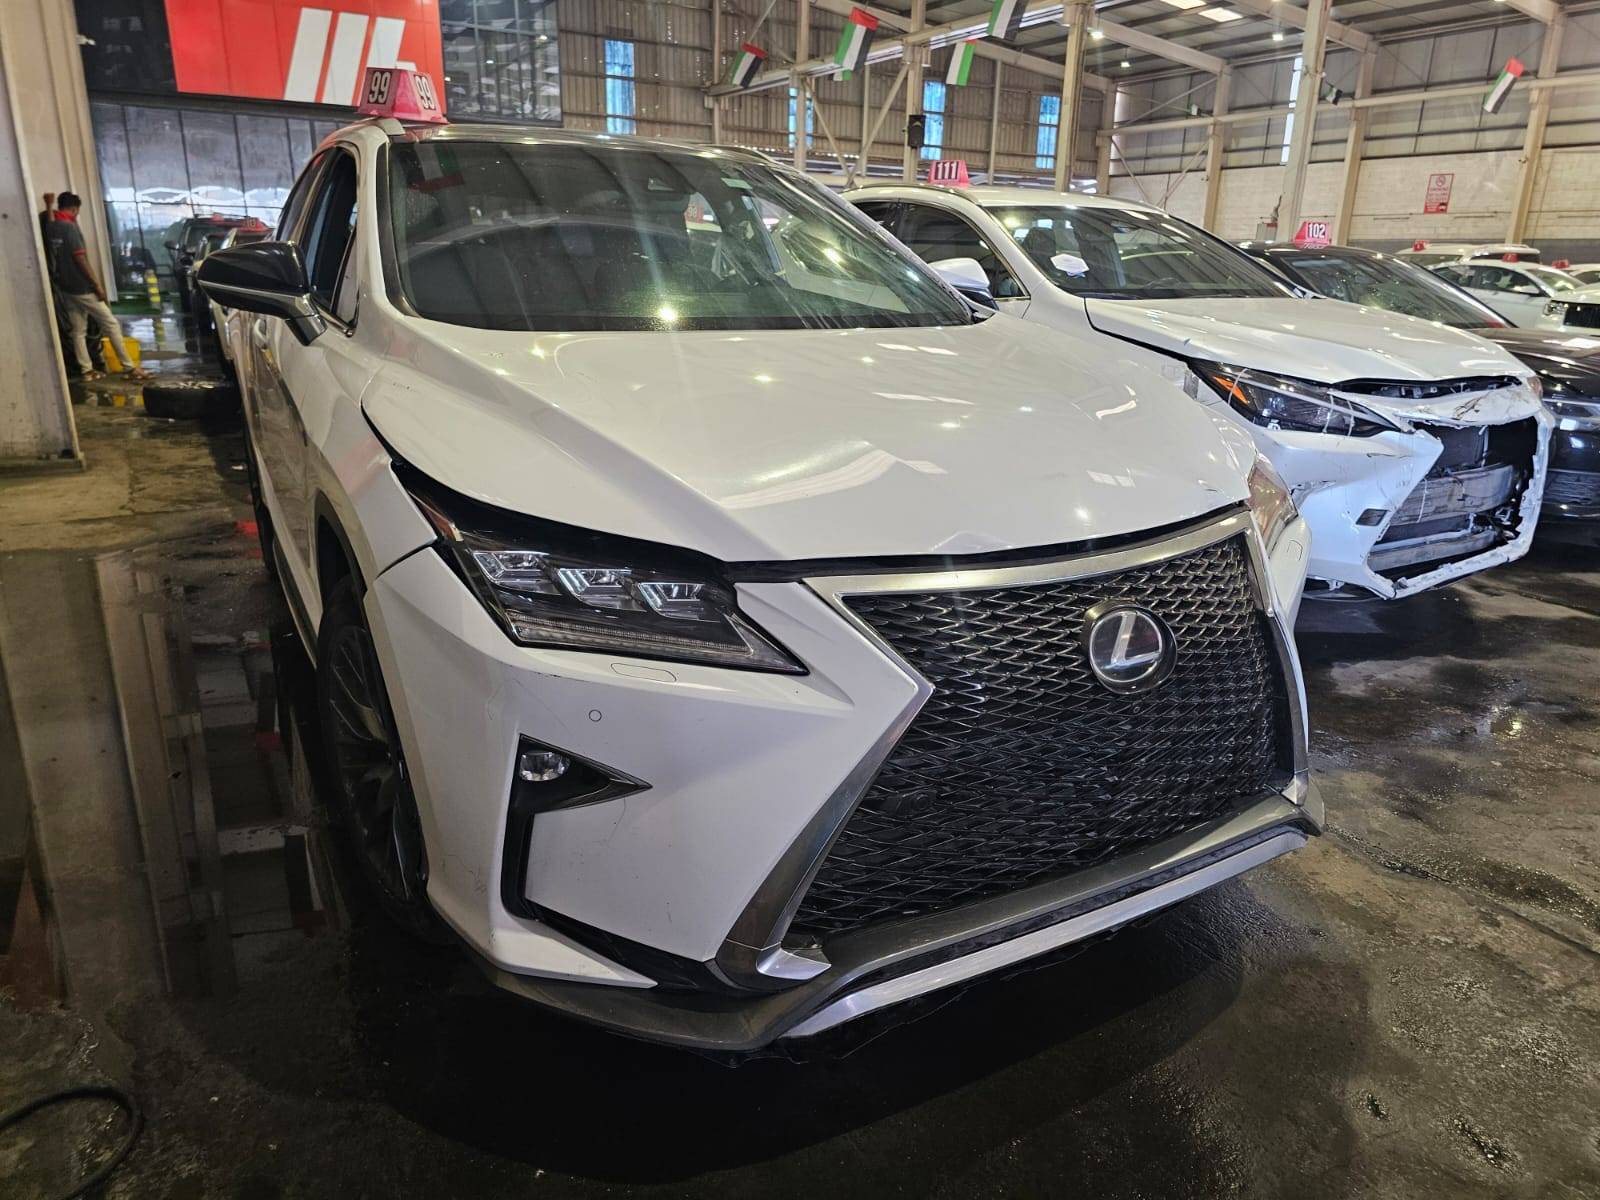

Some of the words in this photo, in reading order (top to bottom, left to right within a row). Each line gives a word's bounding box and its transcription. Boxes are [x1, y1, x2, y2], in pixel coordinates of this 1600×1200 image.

[368, 71, 391, 103] 99
[414, 75, 436, 109] 99
[936, 161, 957, 180] 111
[1308, 223, 1326, 239] 102
